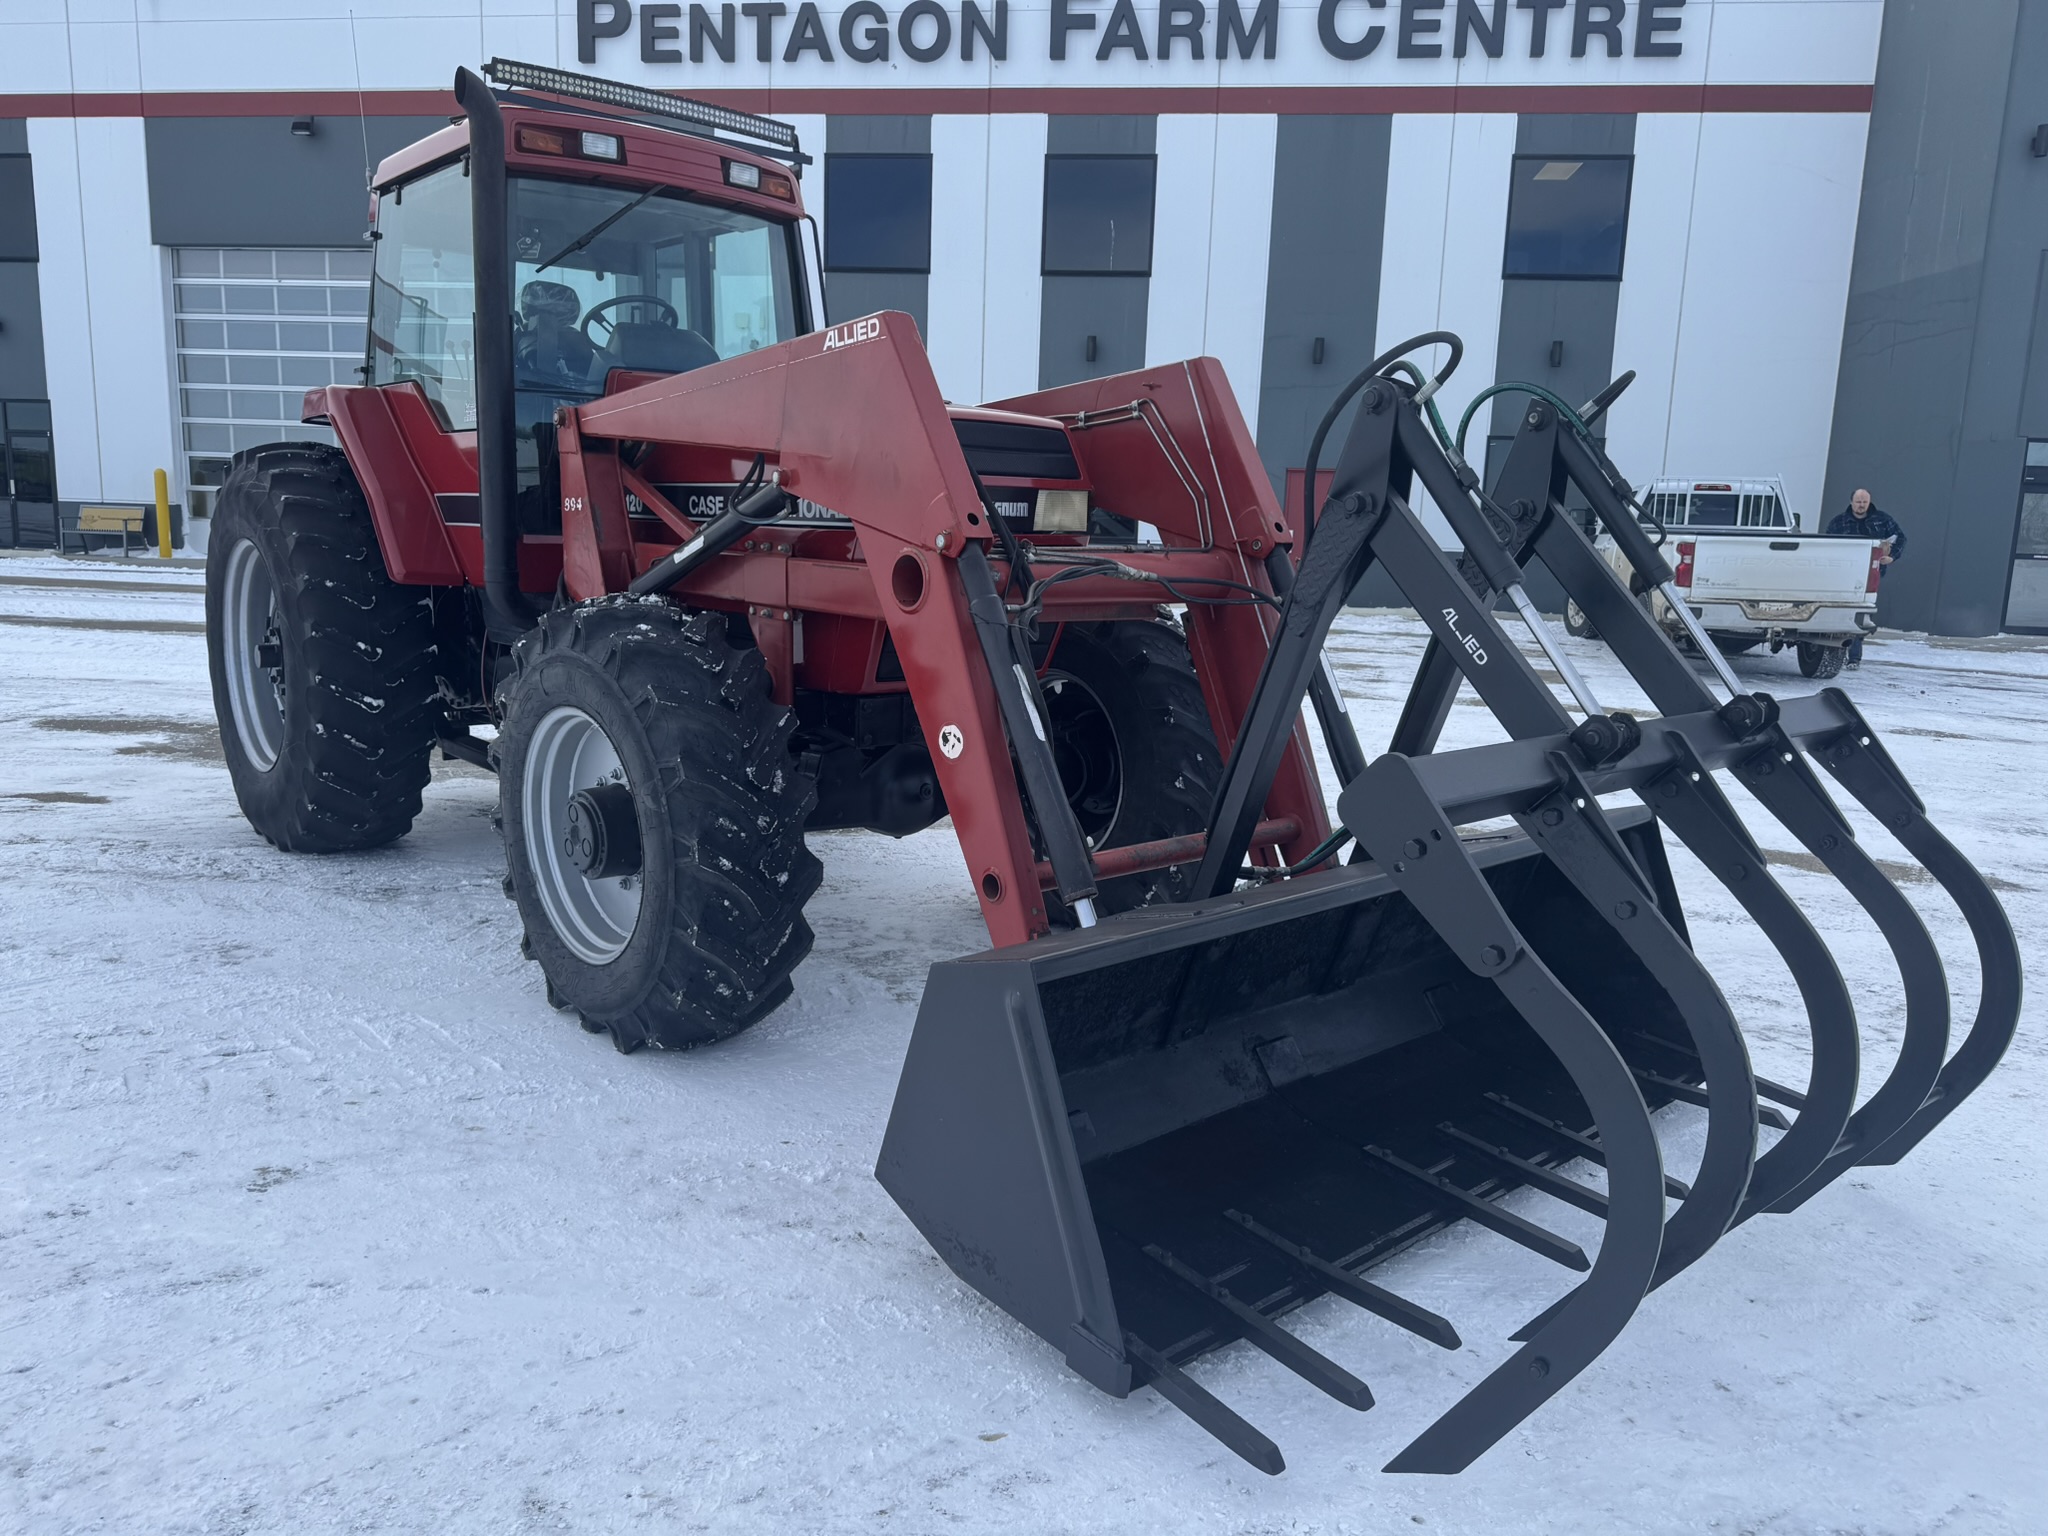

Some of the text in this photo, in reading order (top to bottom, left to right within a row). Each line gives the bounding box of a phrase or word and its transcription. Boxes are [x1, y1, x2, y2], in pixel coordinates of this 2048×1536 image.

[577, 0, 1686, 64] PENTAGON FARM CENTRE
[823, 317, 880, 351] ALLIED
[564, 496, 583, 512] 894
[688, 495, 724, 515] CASE
